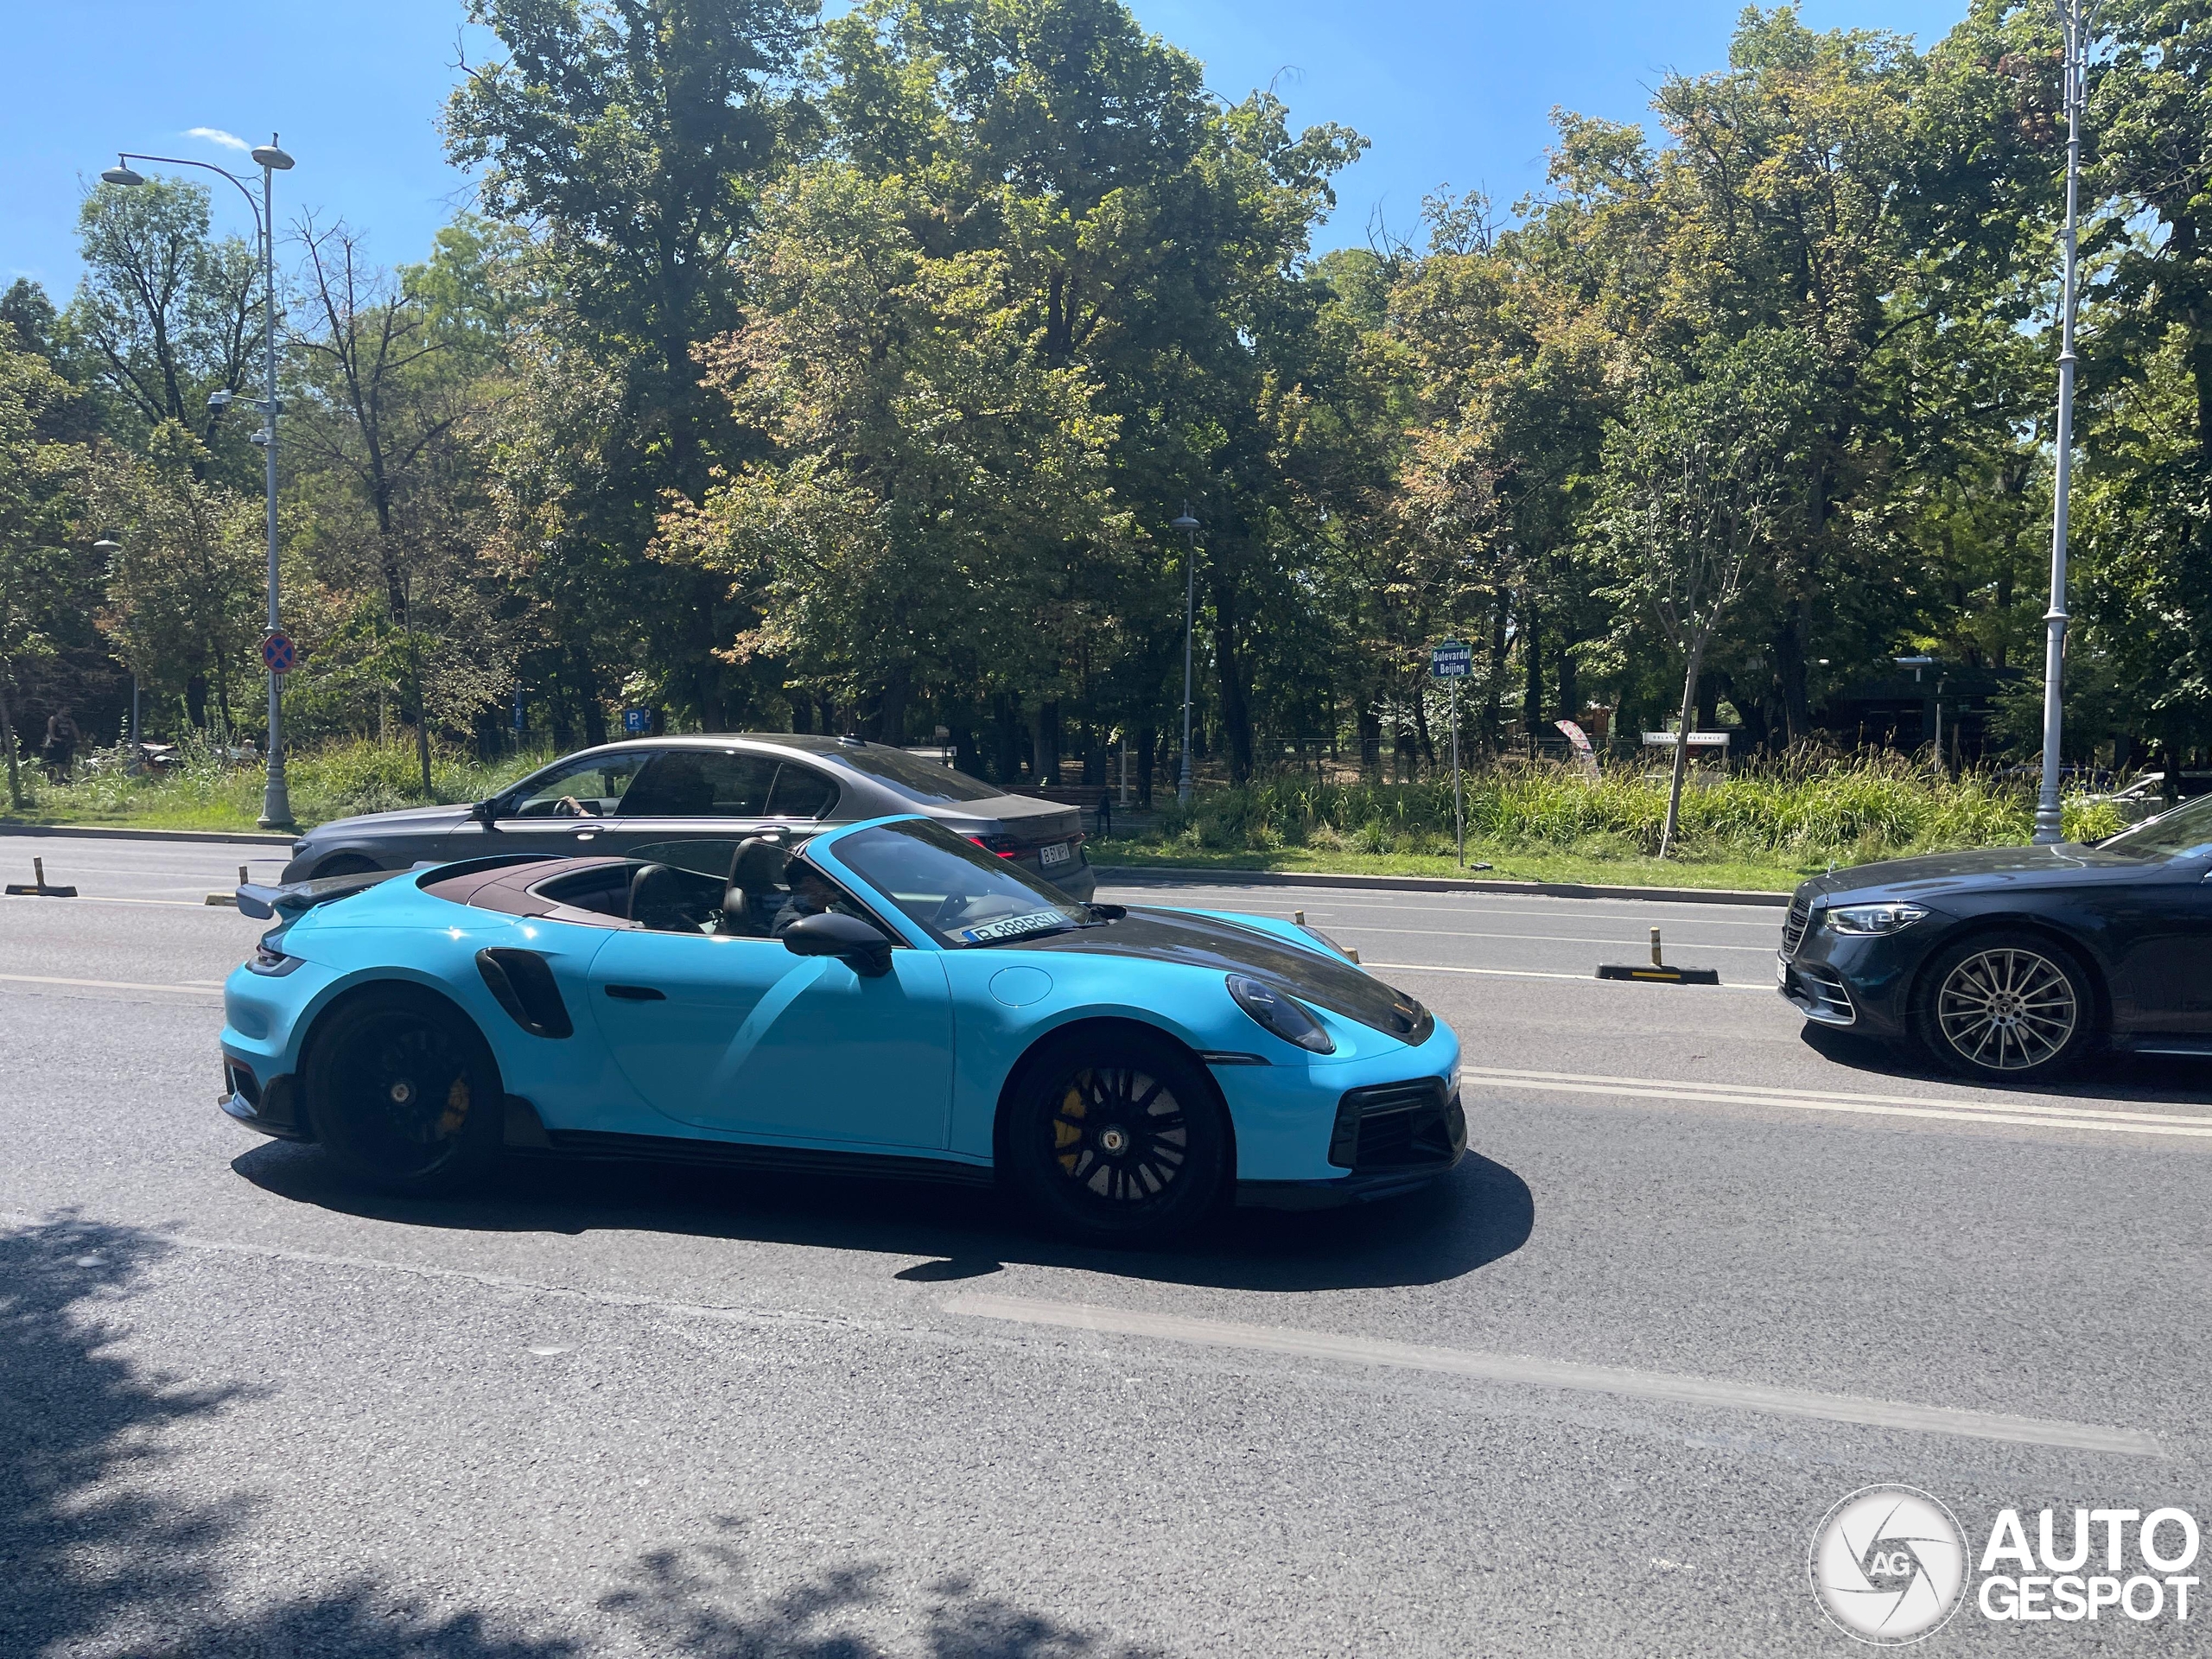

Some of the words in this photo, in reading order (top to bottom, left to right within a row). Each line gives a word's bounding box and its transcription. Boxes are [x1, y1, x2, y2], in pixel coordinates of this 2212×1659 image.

[1433, 649, 1471, 662] Bulevardul
[1440, 663, 1465, 676] Beijing
[629, 712, 639, 725] P
[1043, 849, 1051, 863] B
